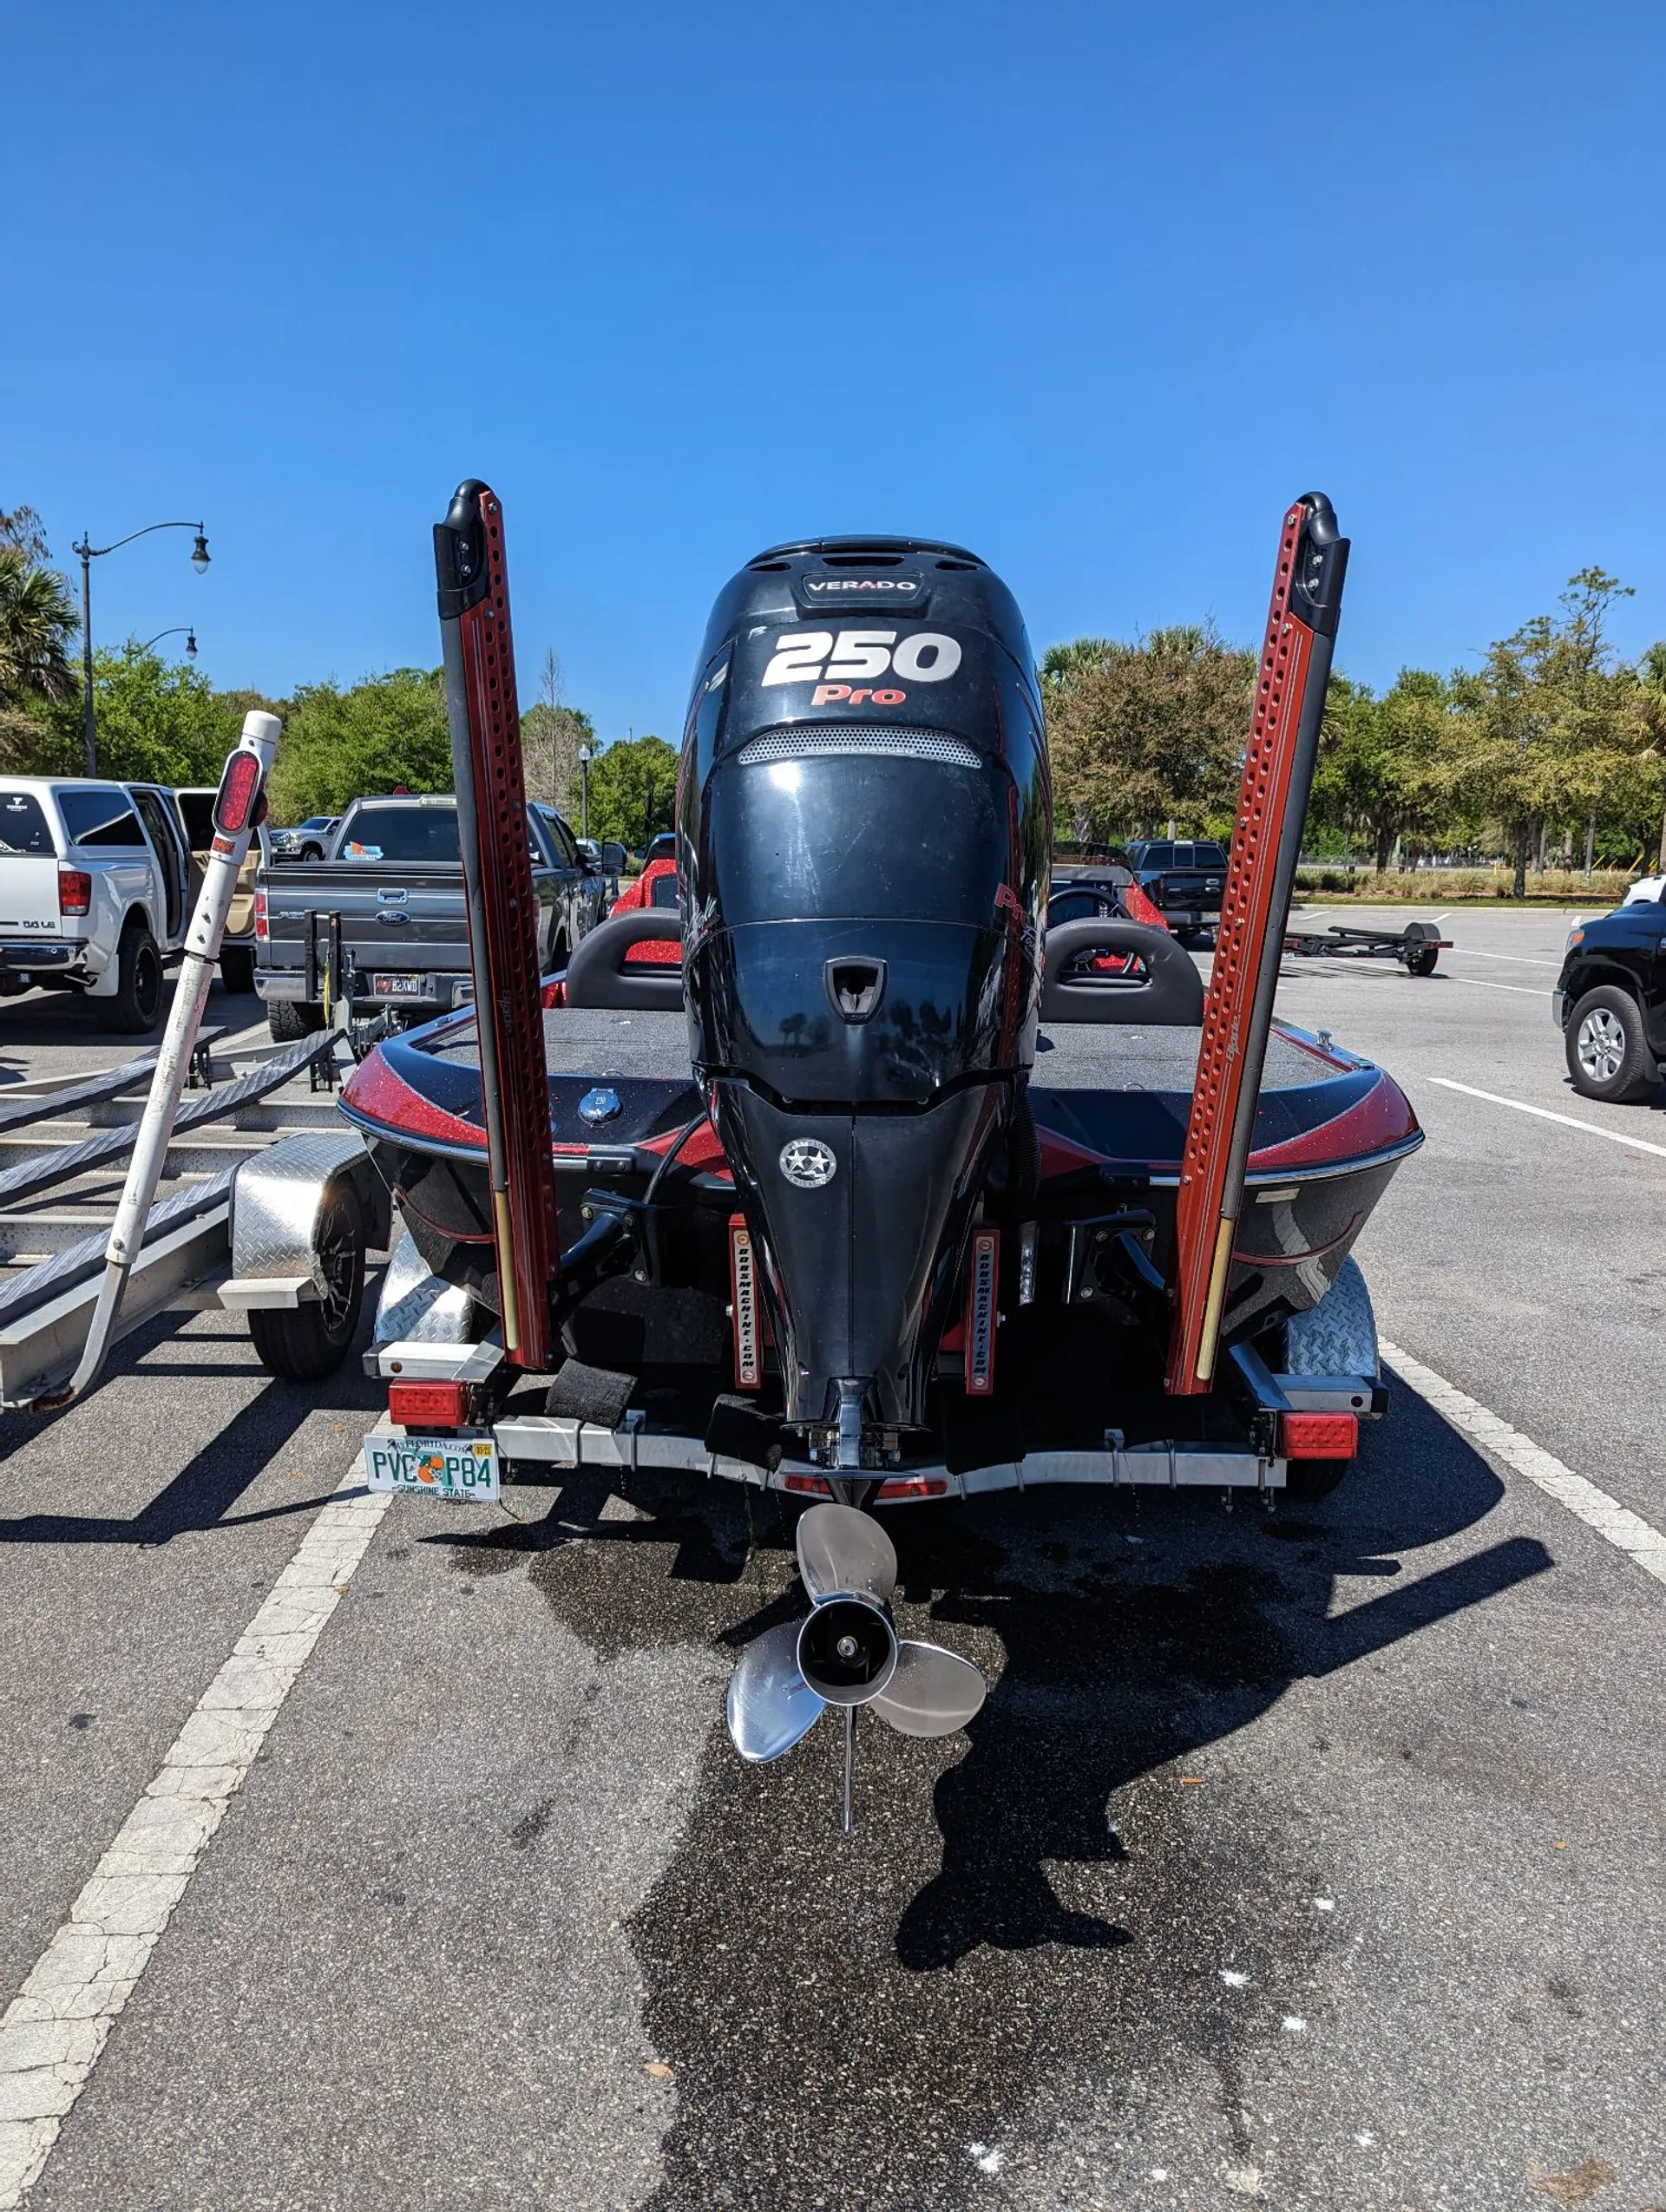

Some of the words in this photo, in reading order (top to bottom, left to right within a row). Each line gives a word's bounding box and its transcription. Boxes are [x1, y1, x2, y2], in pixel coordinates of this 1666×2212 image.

[808, 581, 917, 592] VERADO
[761, 630, 962, 688] 250
[810, 684, 907, 706] Pro
[738, 1247, 755, 1368] BOBSMACHINE.COM
[445, 1456, 491, 1489] P84
